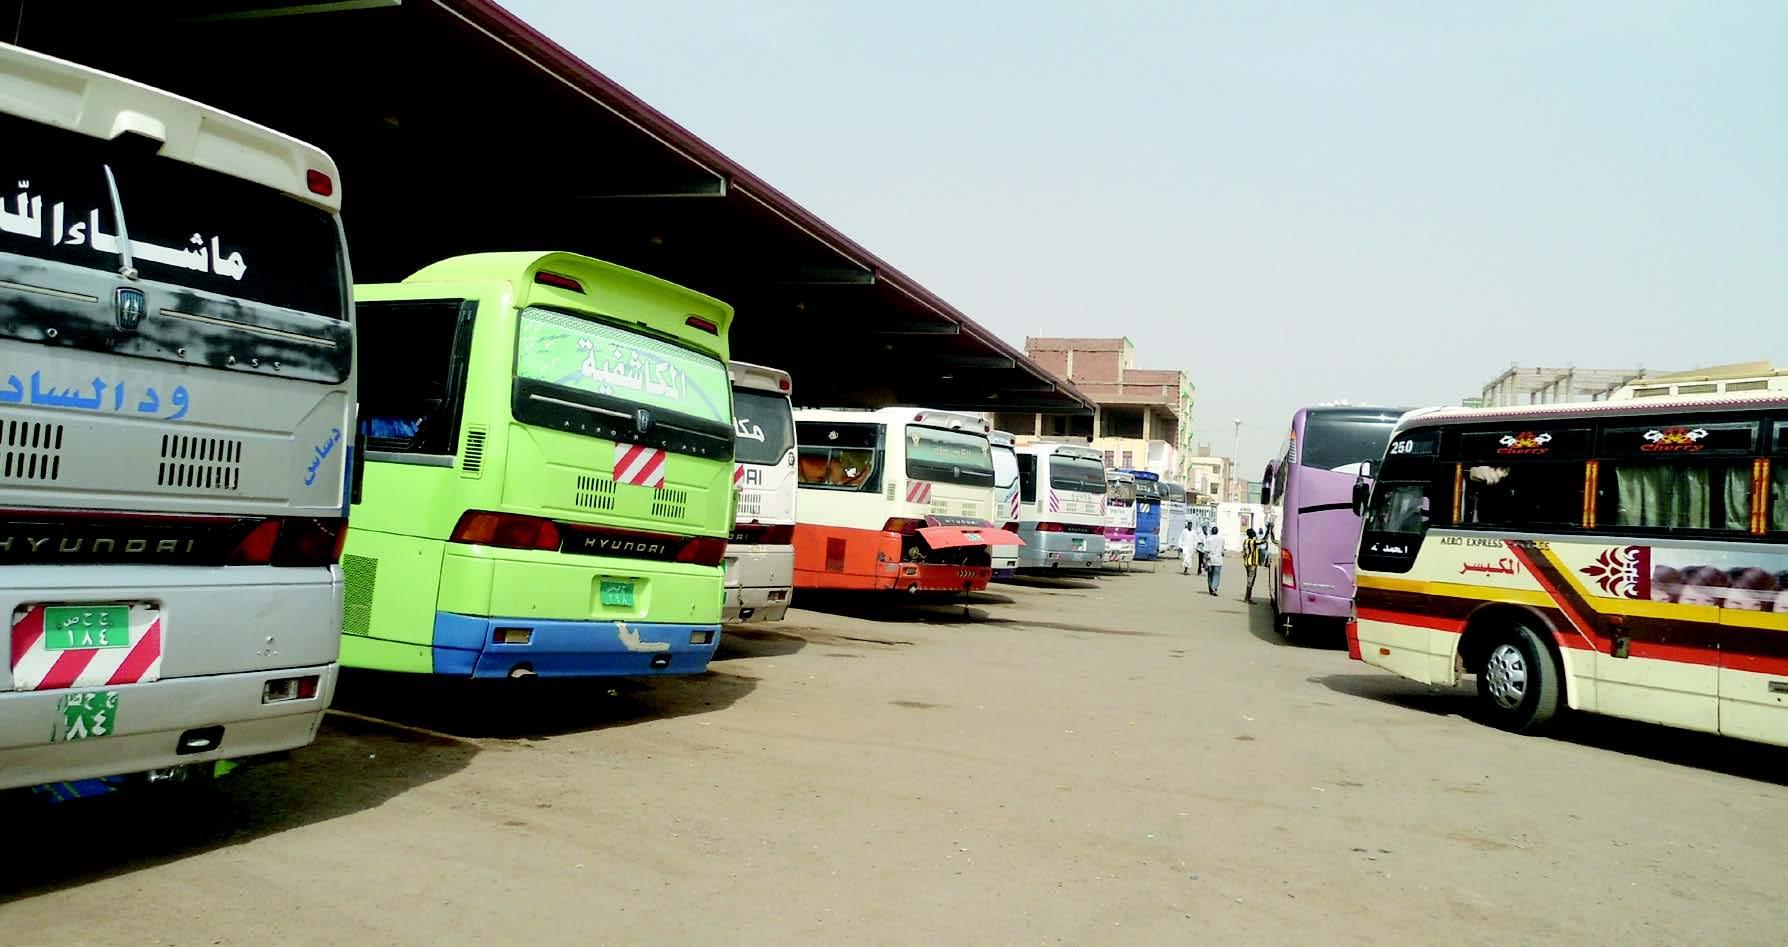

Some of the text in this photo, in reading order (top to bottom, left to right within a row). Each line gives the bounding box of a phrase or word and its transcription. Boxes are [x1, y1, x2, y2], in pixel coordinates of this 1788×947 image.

[1391, 439, 1413, 455] 250
[1640, 443, 1705, 453] Cherry
[584, 537, 665, 555] HYUNDAI
[1440, 536, 1463, 546] AERO
[1466, 538, 1503, 549] EXPRESS
